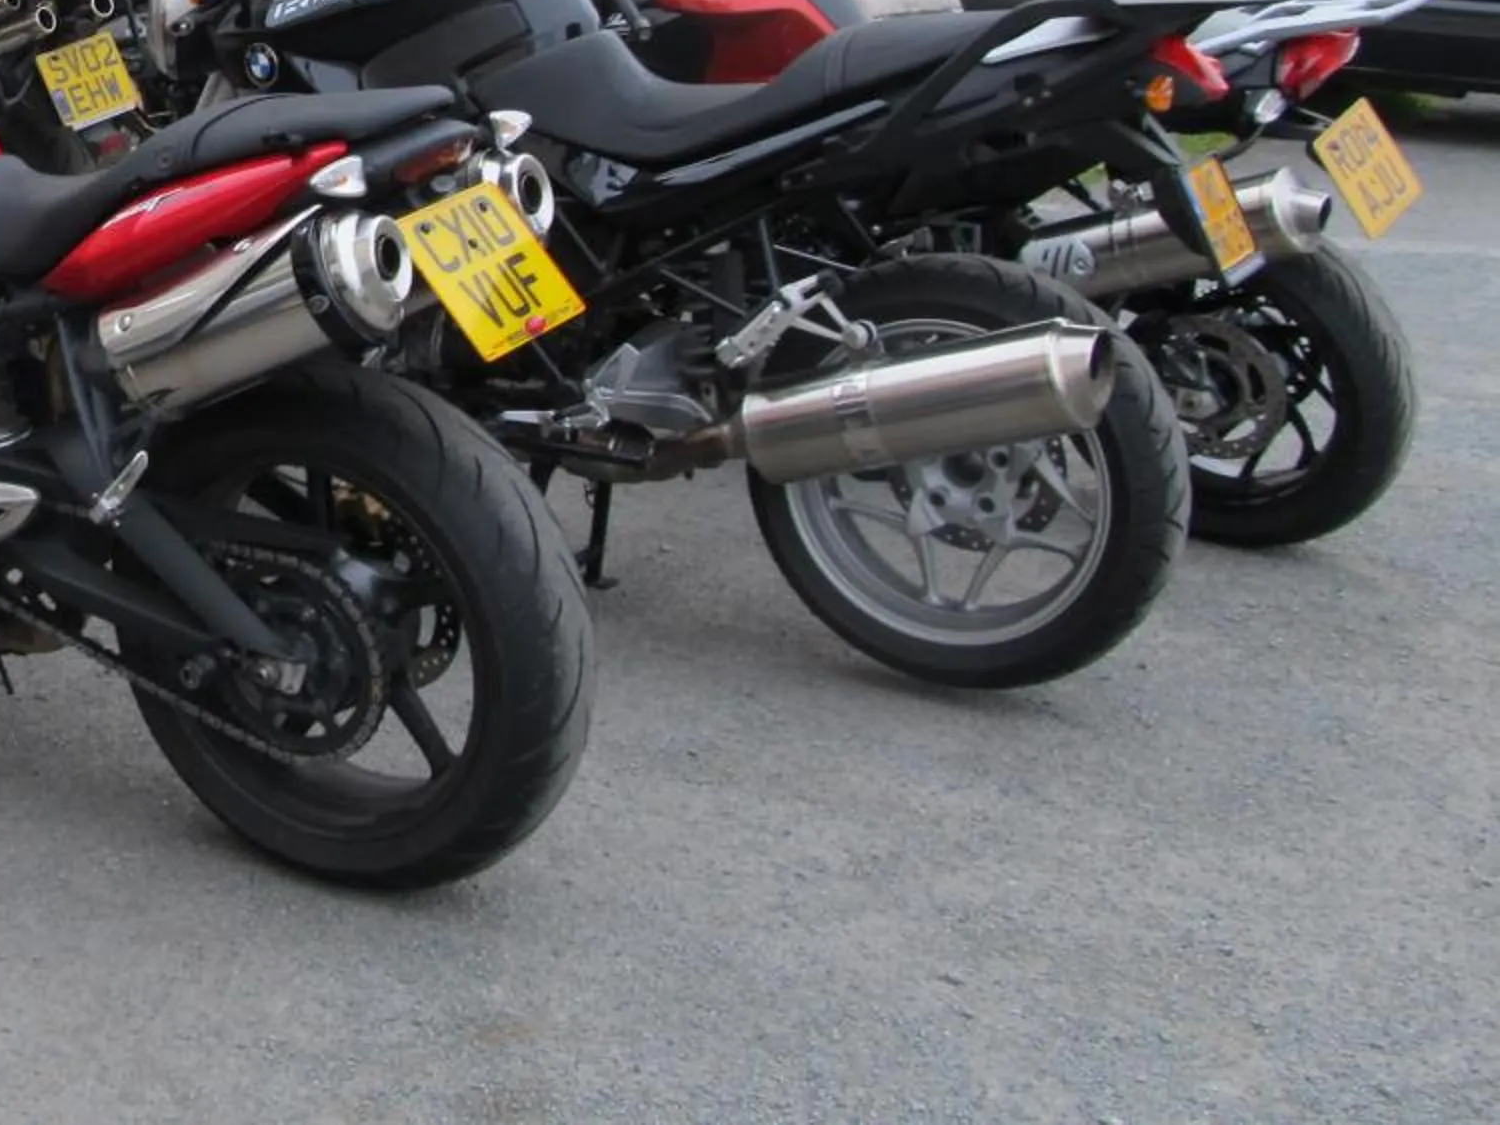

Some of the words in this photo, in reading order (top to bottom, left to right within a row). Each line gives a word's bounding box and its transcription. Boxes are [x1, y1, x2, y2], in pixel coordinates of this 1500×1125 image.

[47, 37, 118, 83] SV02
[68, 72, 124, 114] EHW
[413, 195, 516, 273] CX10
[457, 252, 542, 328] VUF
